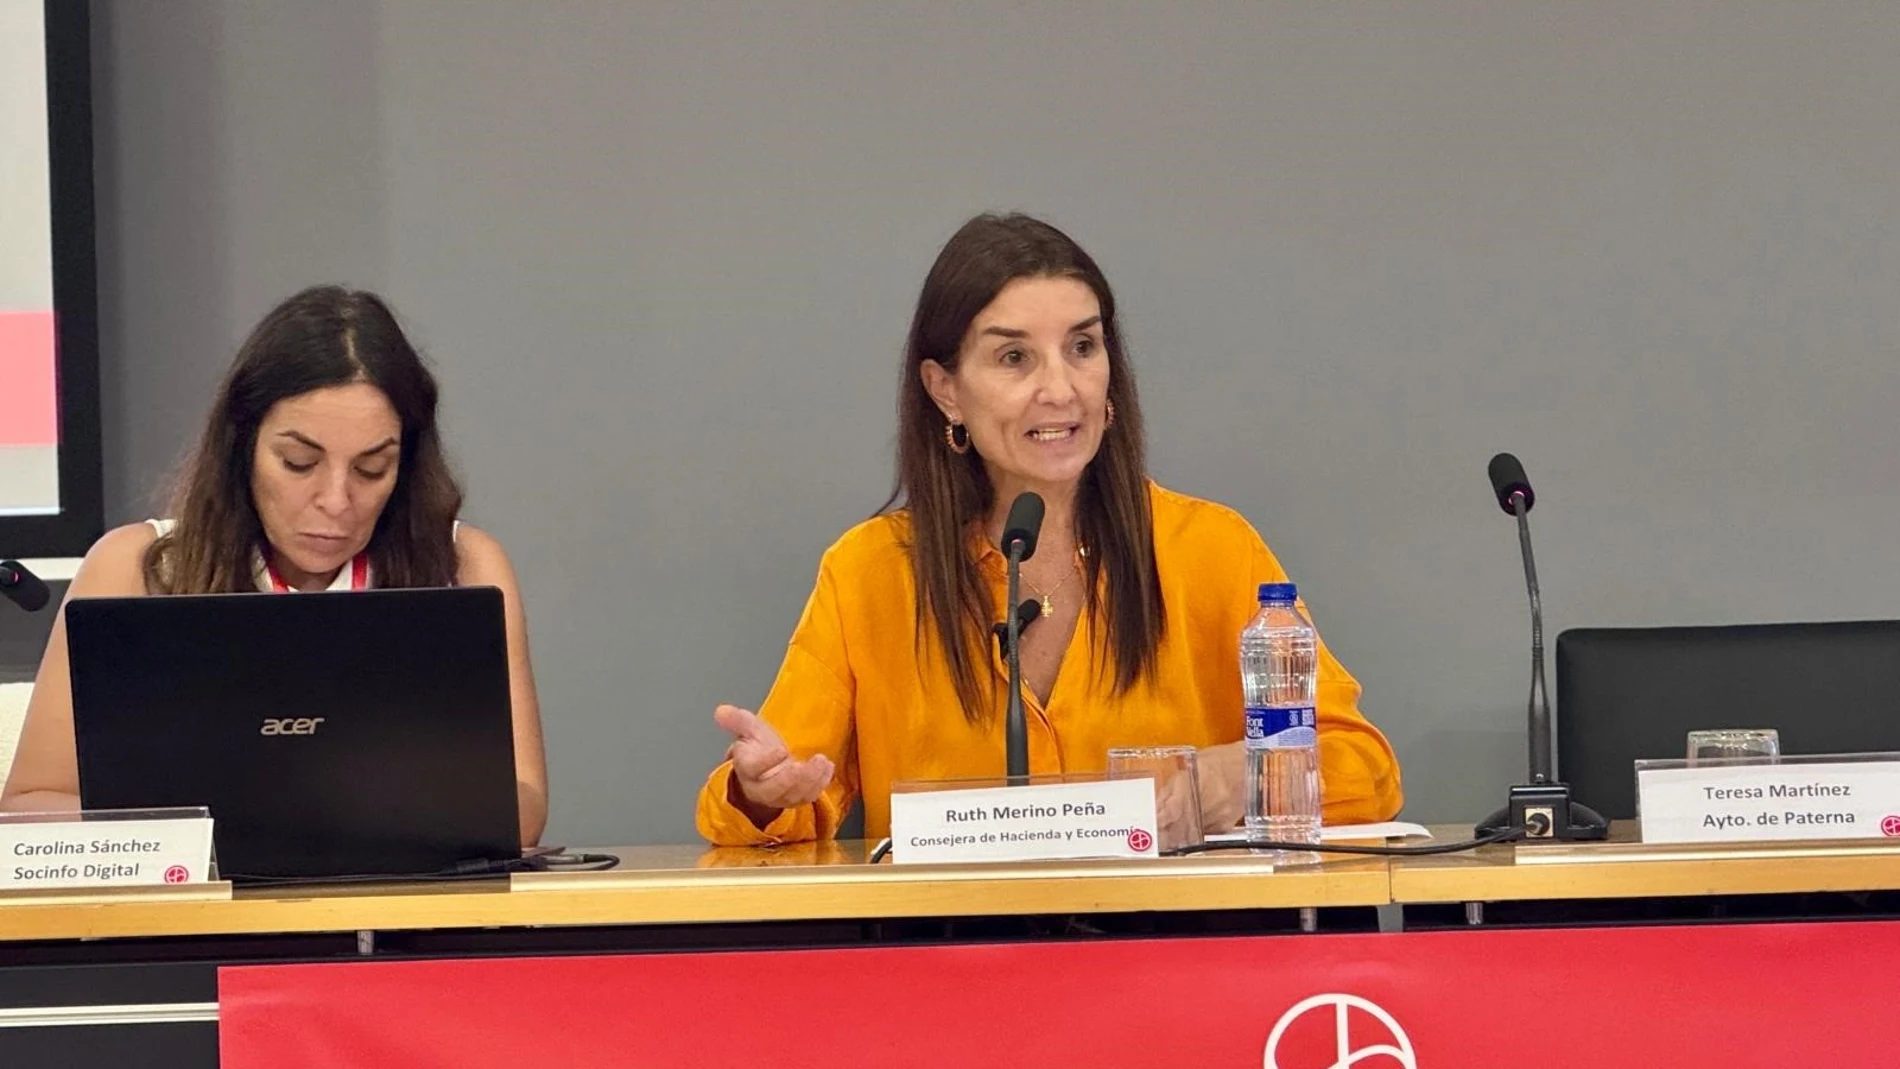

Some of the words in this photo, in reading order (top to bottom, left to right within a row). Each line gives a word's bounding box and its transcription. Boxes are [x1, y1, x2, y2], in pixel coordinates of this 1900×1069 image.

[261, 717, 325, 735] acer
[1703, 786, 1763, 801] Teresa
[1769, 783, 1851, 799] Martínez
[946, 807, 987, 823] Ruth
[993, 804, 1057, 820] Merino
[1062, 802, 1106, 817] Peña
[1703, 813, 1751, 830] Ayto.
[1757, 812, 1779, 826] de
[1784, 811, 1856, 825] Paterna
[911, 832, 976, 848] Consejera
[980, 831, 996, 844] de
[1000, 829, 1062, 842] Hacienda
[1065, 830, 1073, 841] y
[1076, 825, 1141, 839] Economí
[14, 841, 85, 856] Carolina
[90, 839, 161, 854] Sánchez
[14, 864, 78, 880] Socinfo
[83, 863, 140, 880] Digital
